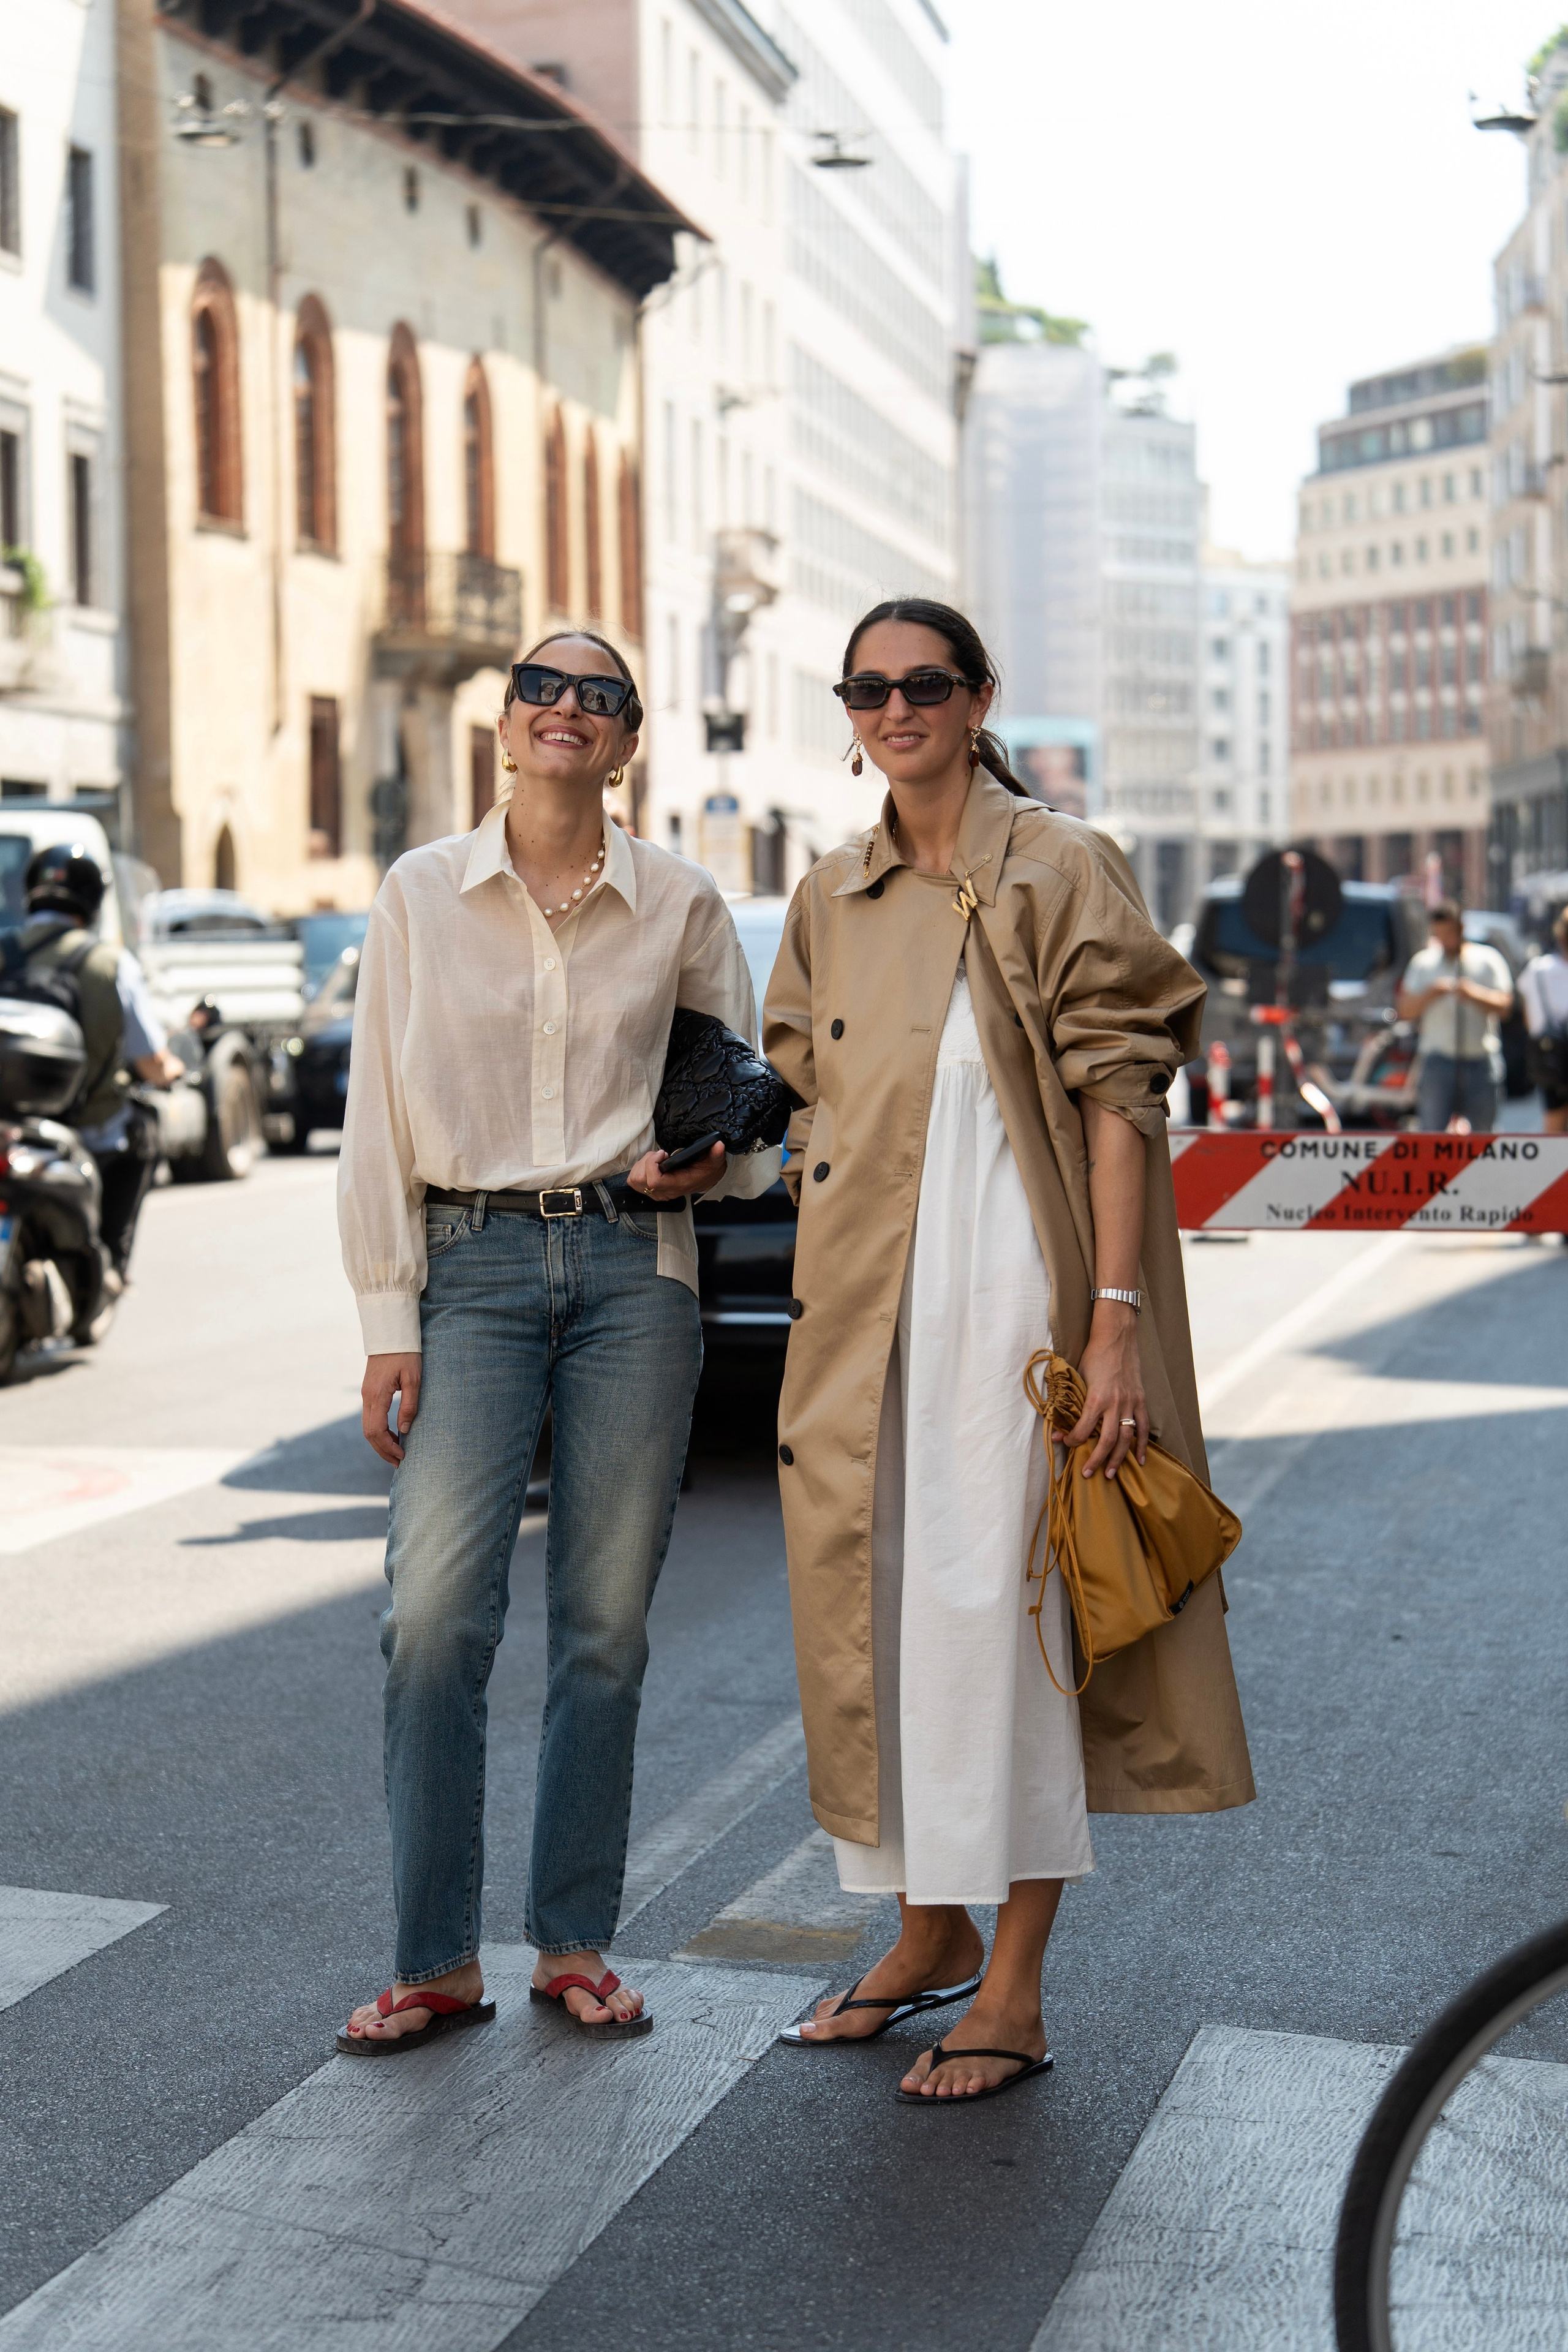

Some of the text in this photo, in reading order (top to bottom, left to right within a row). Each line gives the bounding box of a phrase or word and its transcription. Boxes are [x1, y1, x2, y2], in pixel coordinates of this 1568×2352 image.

[1261, 1140, 1539, 1160] COMUNE DI MILANO
[1340, 1170, 1459, 1195] NU.I.R.
[1267, 1204, 1534, 1225] Nucleo Intervento Rapido
